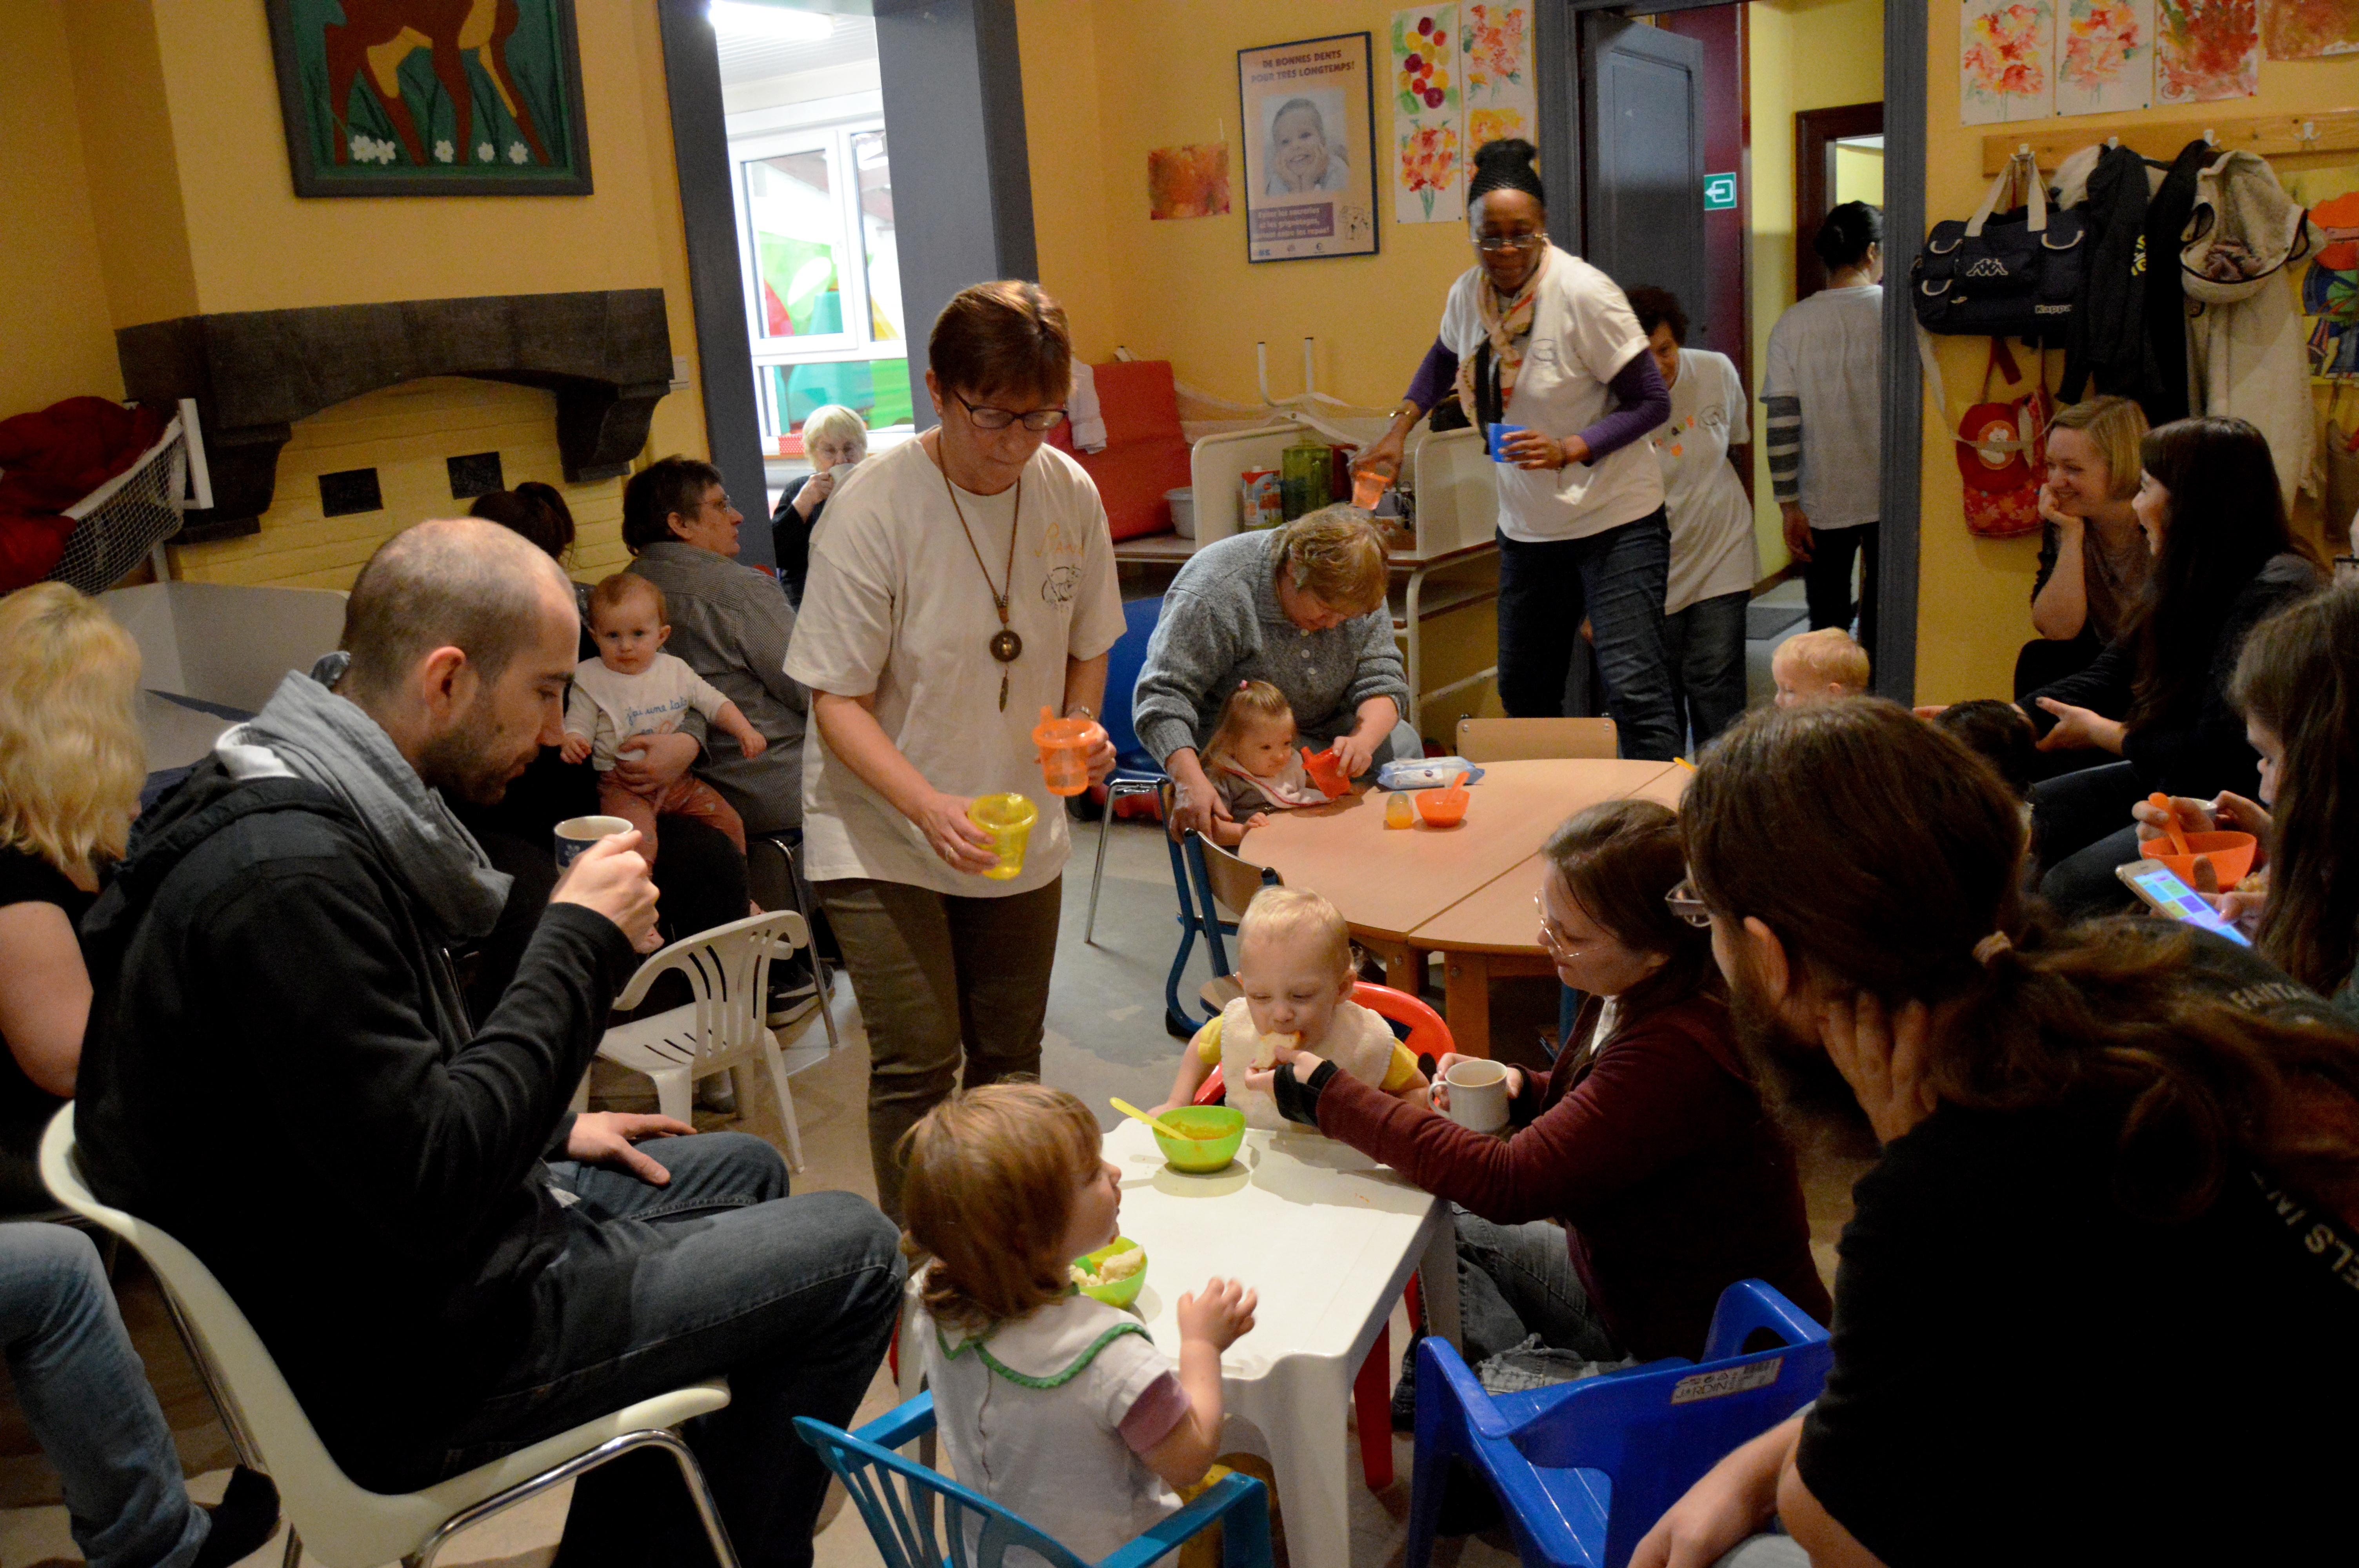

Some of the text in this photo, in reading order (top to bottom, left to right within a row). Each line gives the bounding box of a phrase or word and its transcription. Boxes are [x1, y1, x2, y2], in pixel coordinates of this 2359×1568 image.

[1263, 50, 1342, 68] DE BONNES DENTS
[1252, 73, 1274, 83] POUR
[1299, 61, 1354, 77] LONGTEMPS!
[2035, 304, 2072, 314] Kappa
[645, 704, 667, 715] une
